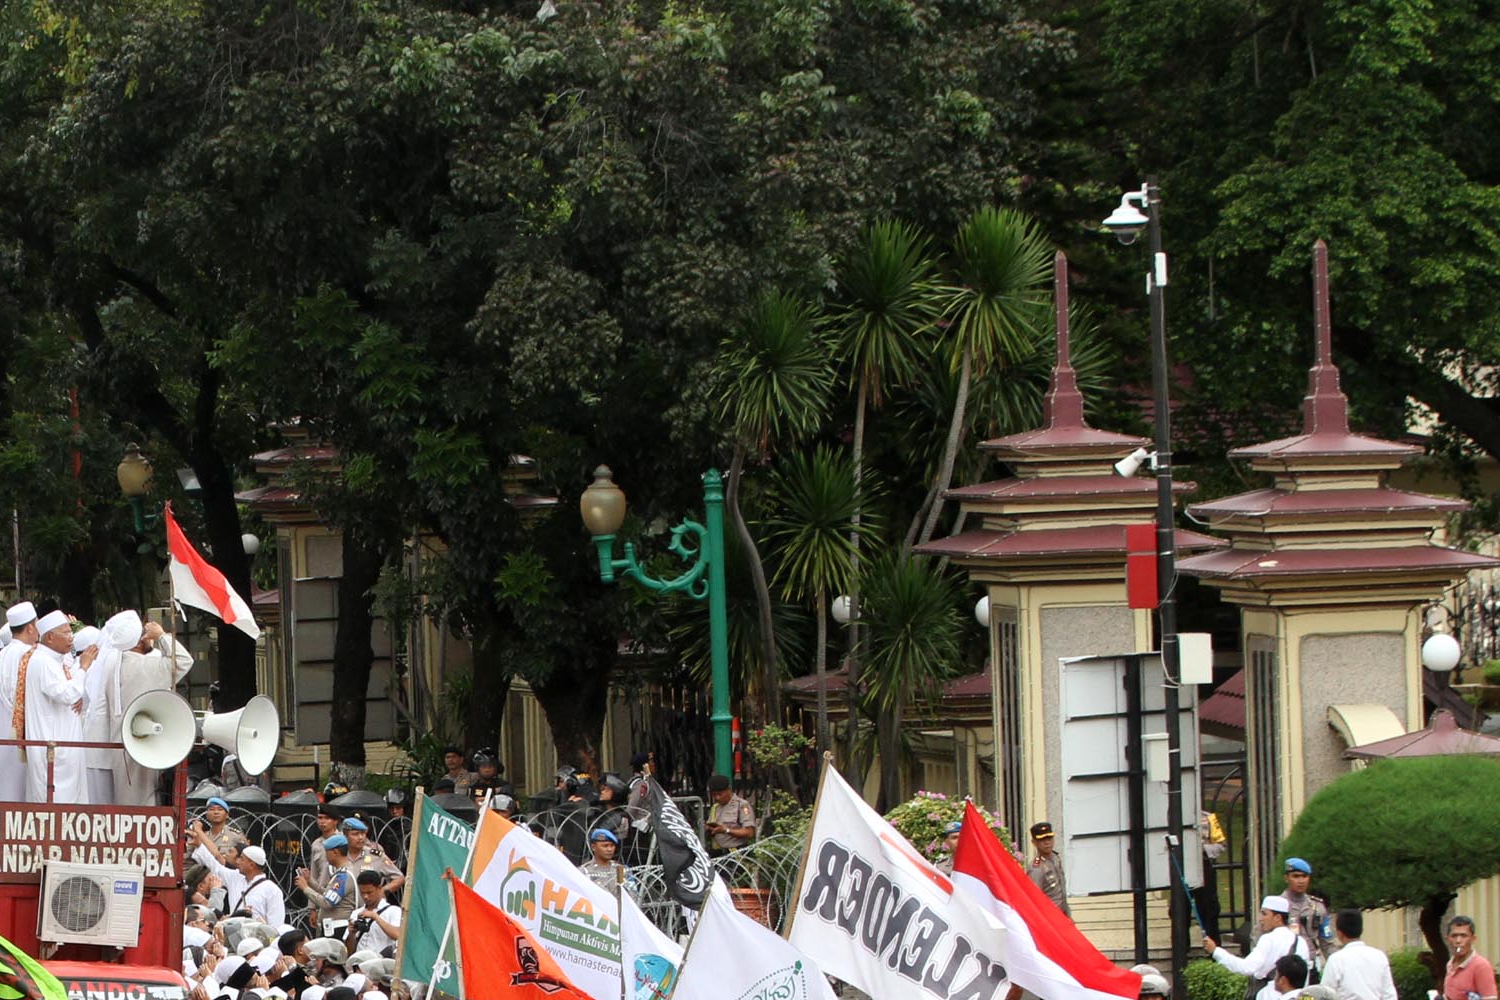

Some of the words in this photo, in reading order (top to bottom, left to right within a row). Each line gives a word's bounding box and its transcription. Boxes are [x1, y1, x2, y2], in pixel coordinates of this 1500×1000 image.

[5, 810, 56, 841] MATI
[61, 811, 176, 846] KORUPTOR
[542, 919, 580, 943] Himpunan
[579, 932, 609, 953] Aktivis
